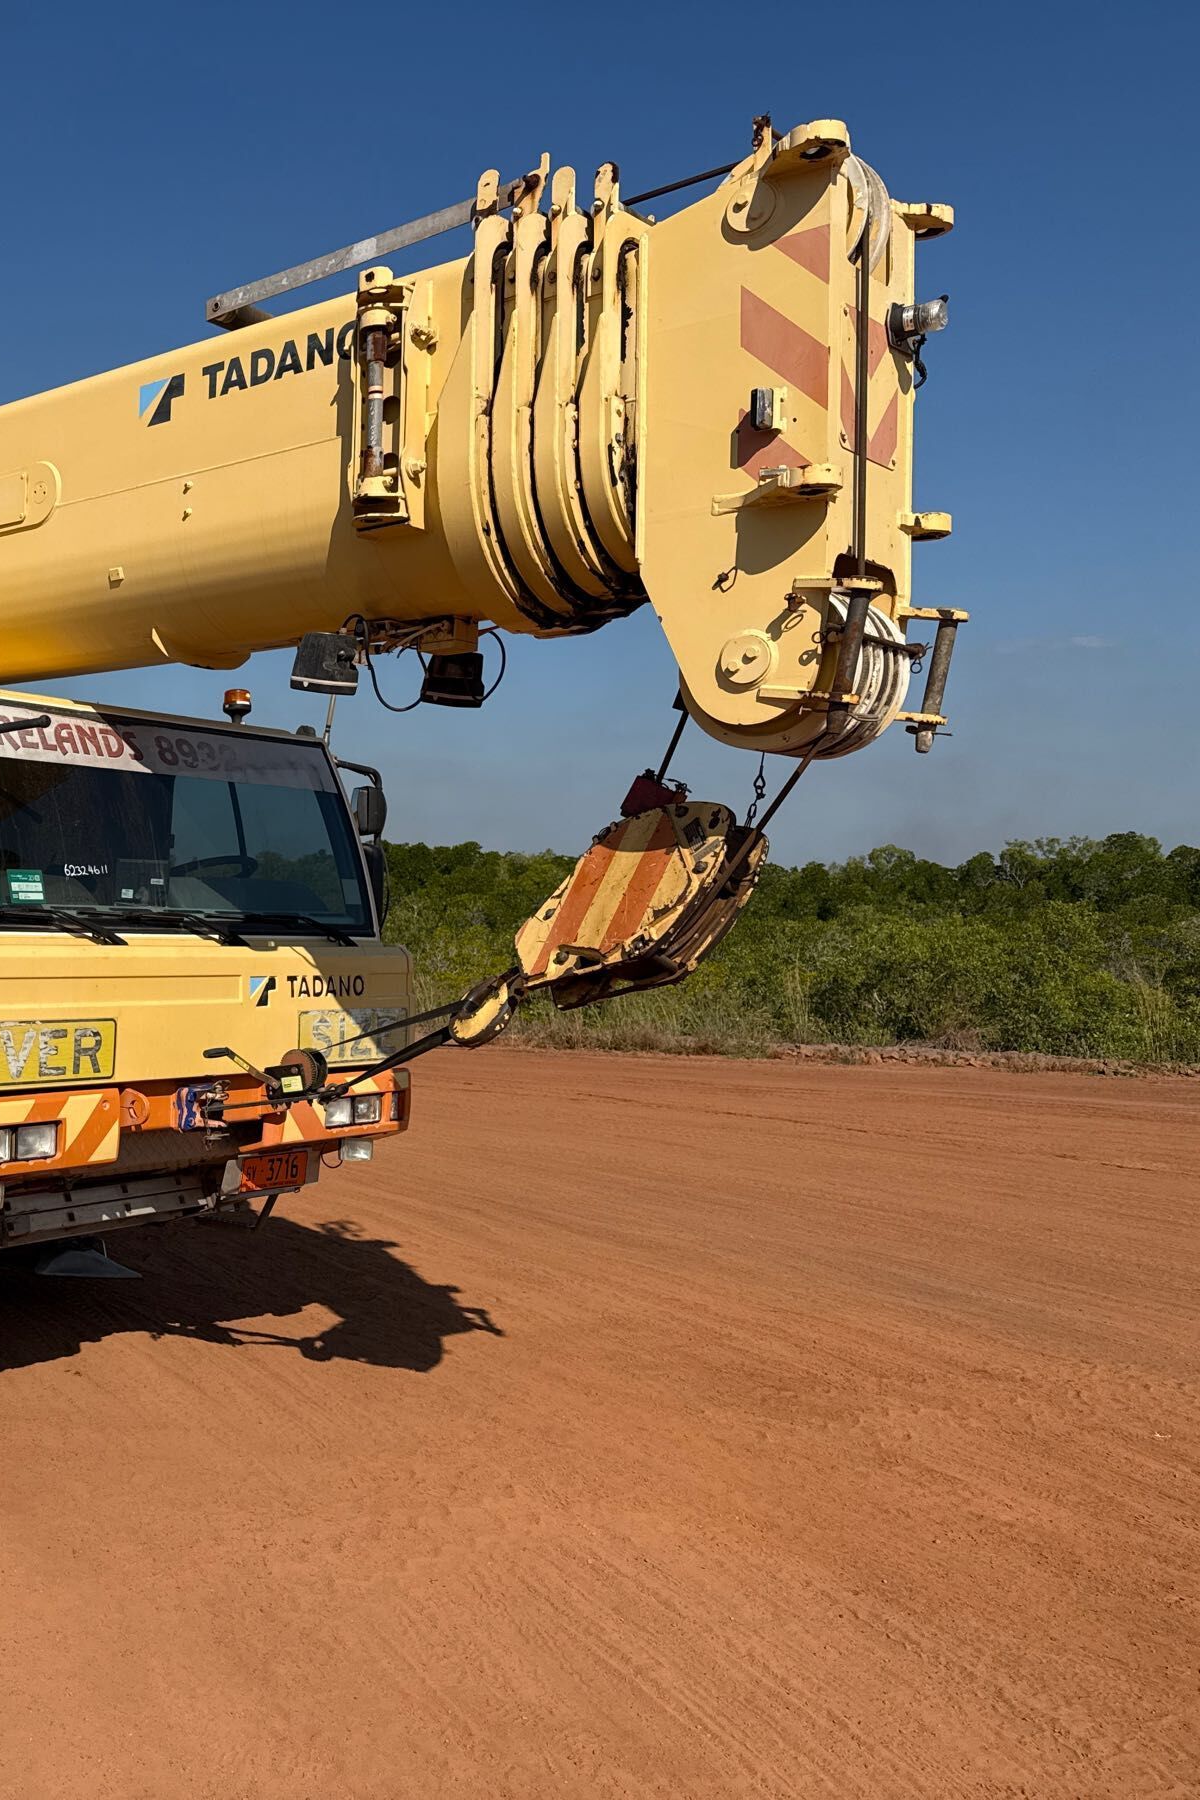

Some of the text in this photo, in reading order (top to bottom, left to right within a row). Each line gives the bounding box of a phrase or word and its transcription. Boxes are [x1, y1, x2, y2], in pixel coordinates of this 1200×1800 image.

[202, 320, 358, 399] TADANO
[64, 863, 108, 877] 62324611
[287, 975, 365, 998] TADANO
[266, 1154, 299, 1181] 3716
